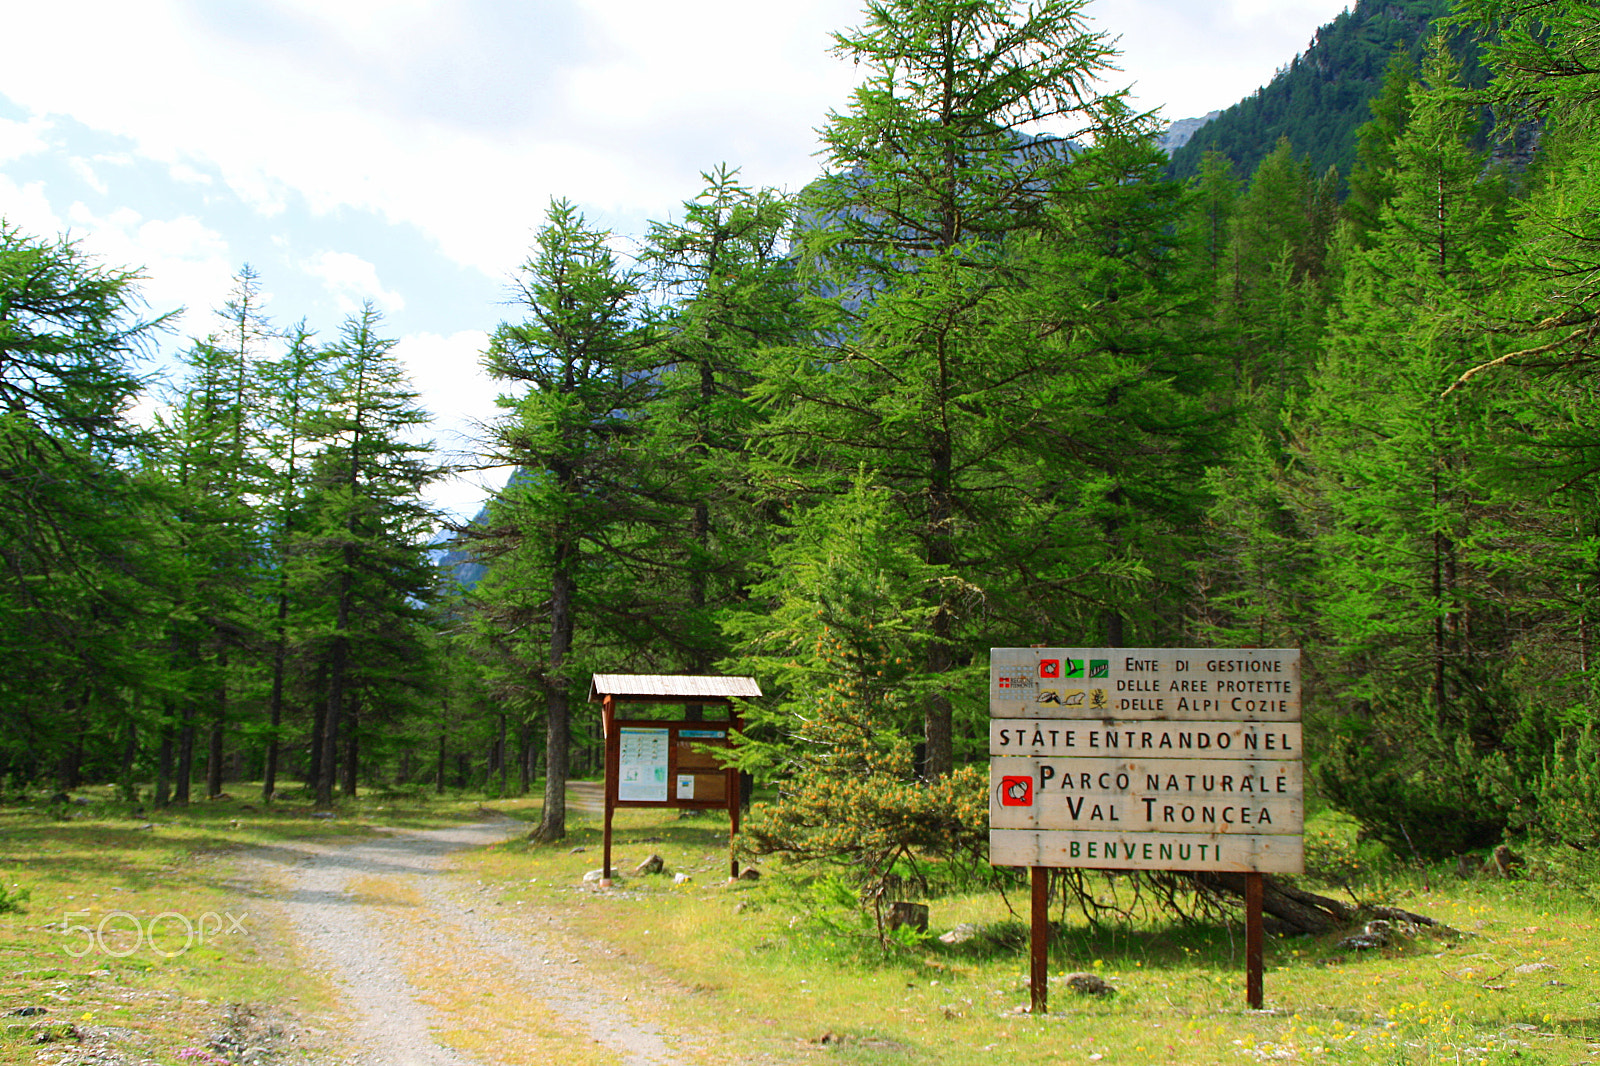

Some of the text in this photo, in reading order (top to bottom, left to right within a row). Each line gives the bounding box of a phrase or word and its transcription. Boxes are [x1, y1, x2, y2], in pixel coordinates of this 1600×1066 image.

[1126, 657, 1282, 672] ENTE DI GESTIONE
[1117, 680, 1291, 693] DELLE AREE PROTETTE
[1121, 697, 1287, 712] DELLE ALPI COZIE
[1000, 729, 1292, 750] STATE ENTRANDO NEL
[1039, 766, 1287, 793] PARCO NATURALE
[1066, 796, 1272, 824] VAL TRONCEA
[1070, 841, 1221, 862] BENVENUTI
